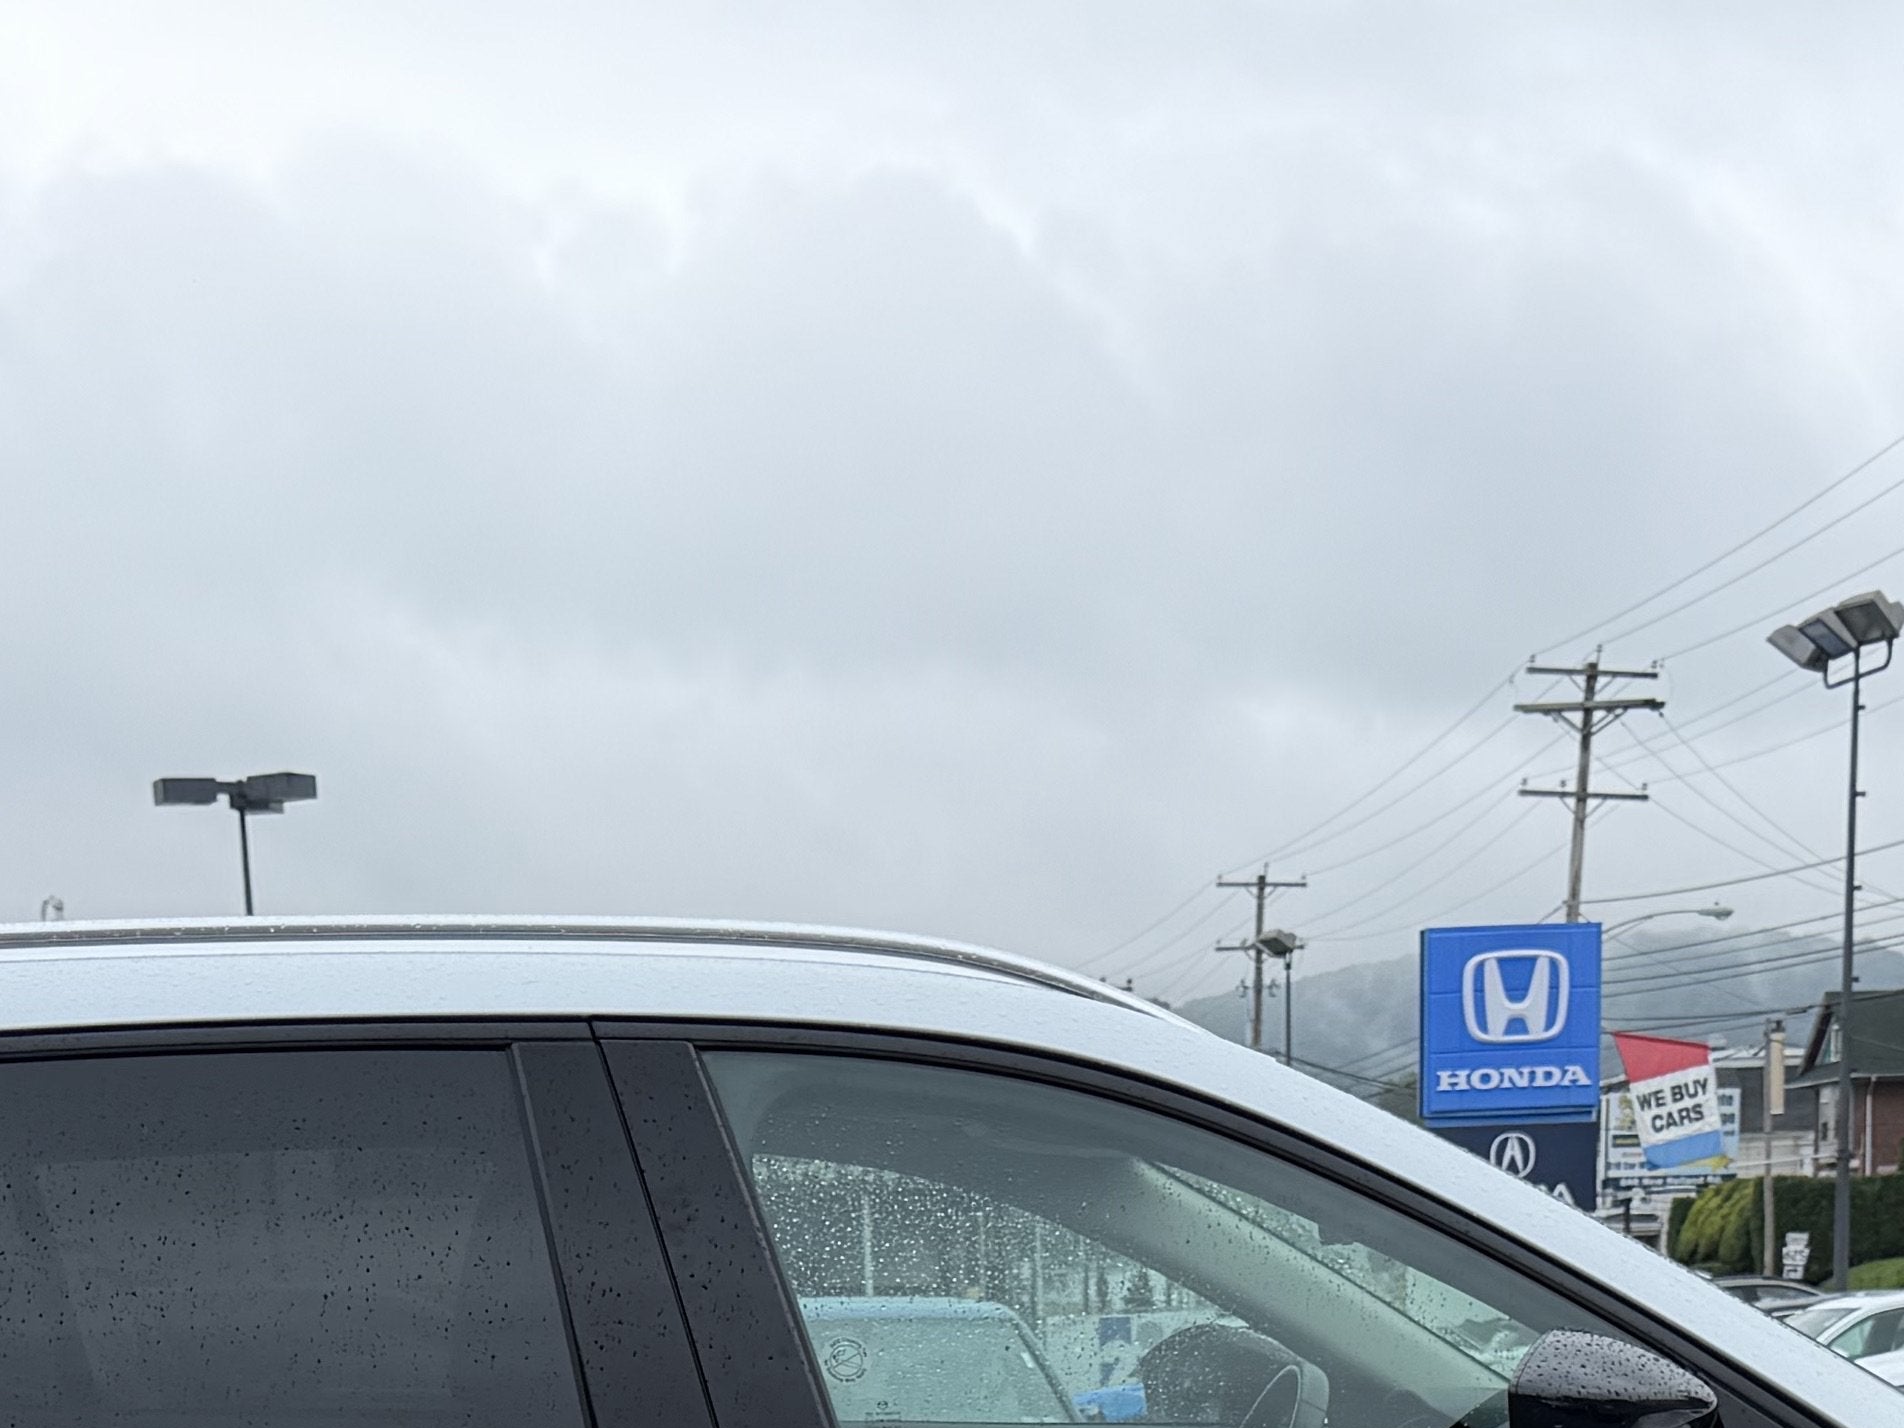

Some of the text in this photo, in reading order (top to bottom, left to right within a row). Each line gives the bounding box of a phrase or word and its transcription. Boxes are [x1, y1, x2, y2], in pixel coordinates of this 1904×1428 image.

[1436, 1065, 1593, 1092] HONDA
[1636, 1089, 1667, 1112] WE
[1670, 1078, 1708, 1104] BUY
[1651, 1103, 1704, 1133] CARS
